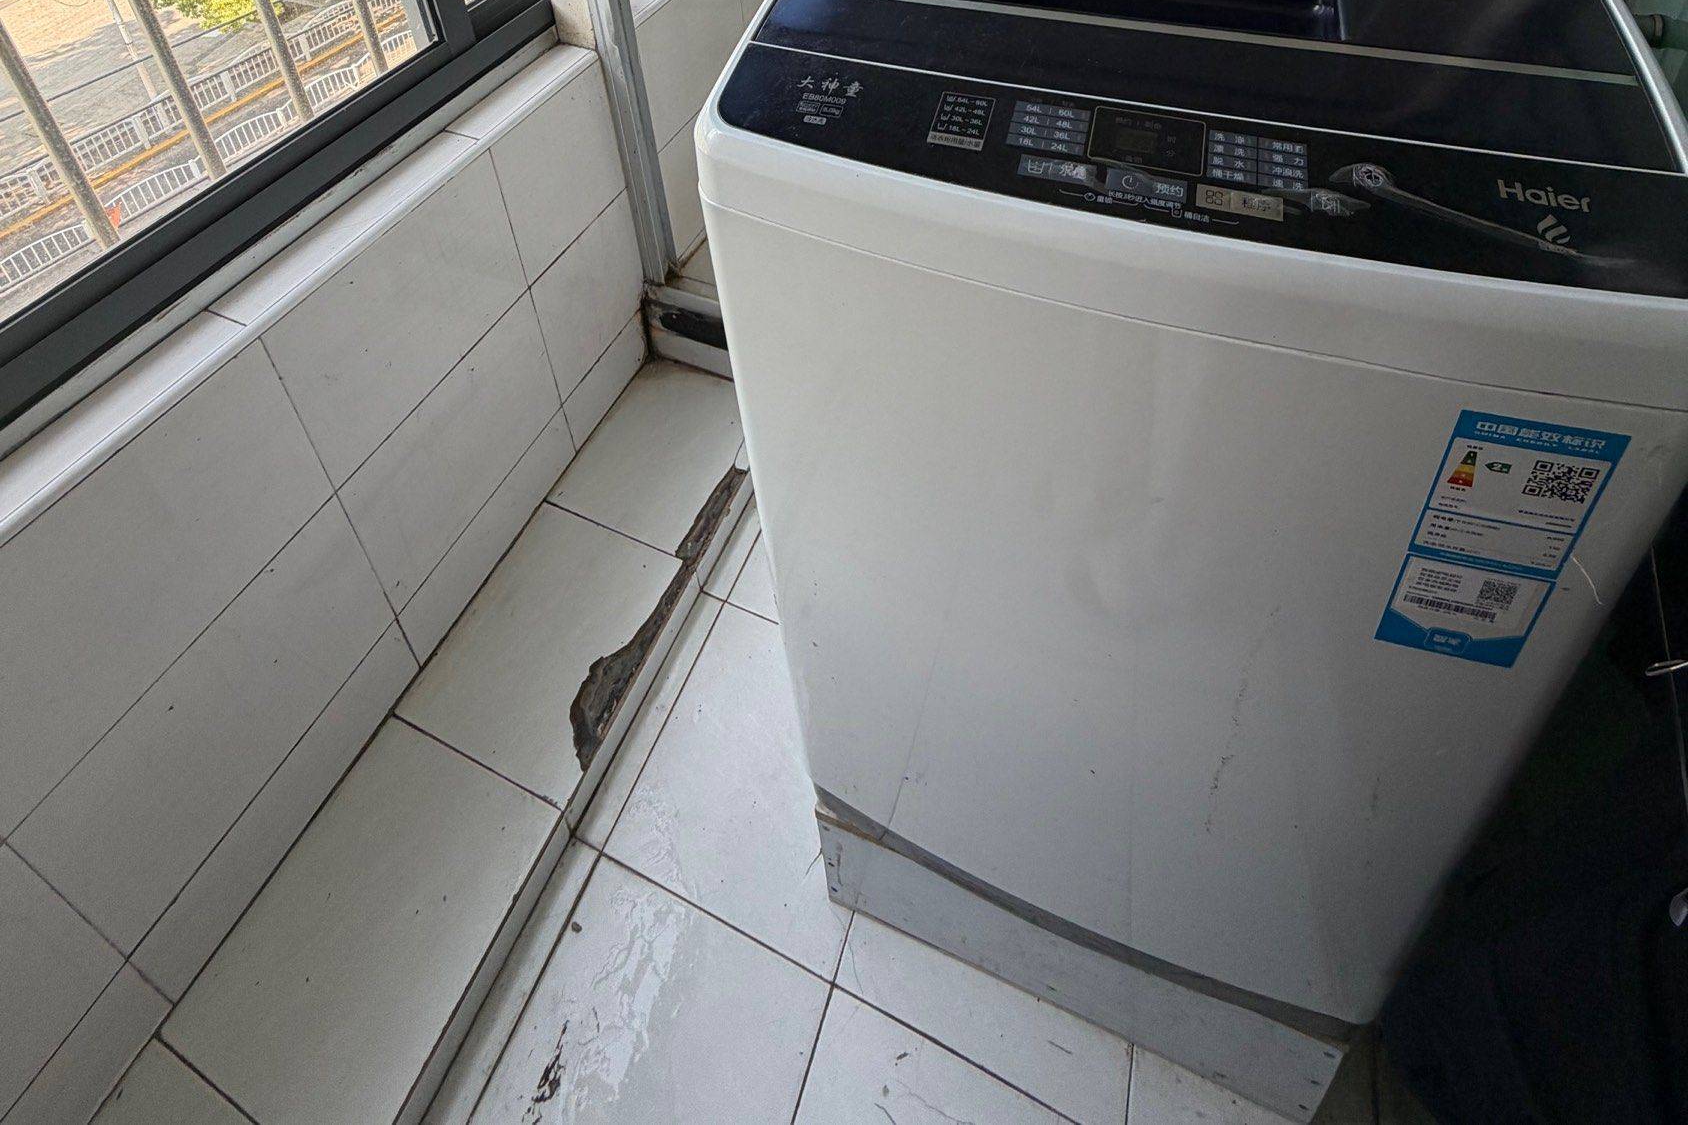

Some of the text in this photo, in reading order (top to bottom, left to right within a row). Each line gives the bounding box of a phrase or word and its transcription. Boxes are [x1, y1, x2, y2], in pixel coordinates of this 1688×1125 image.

[797, 75, 864, 98] 大神童
[1051, 142, 1068, 152] 24L
[1154, 181, 1184, 198] 预约
[1497, 179, 1591, 213] Haier
[1476, 421, 1606, 449] 中国能效标识
